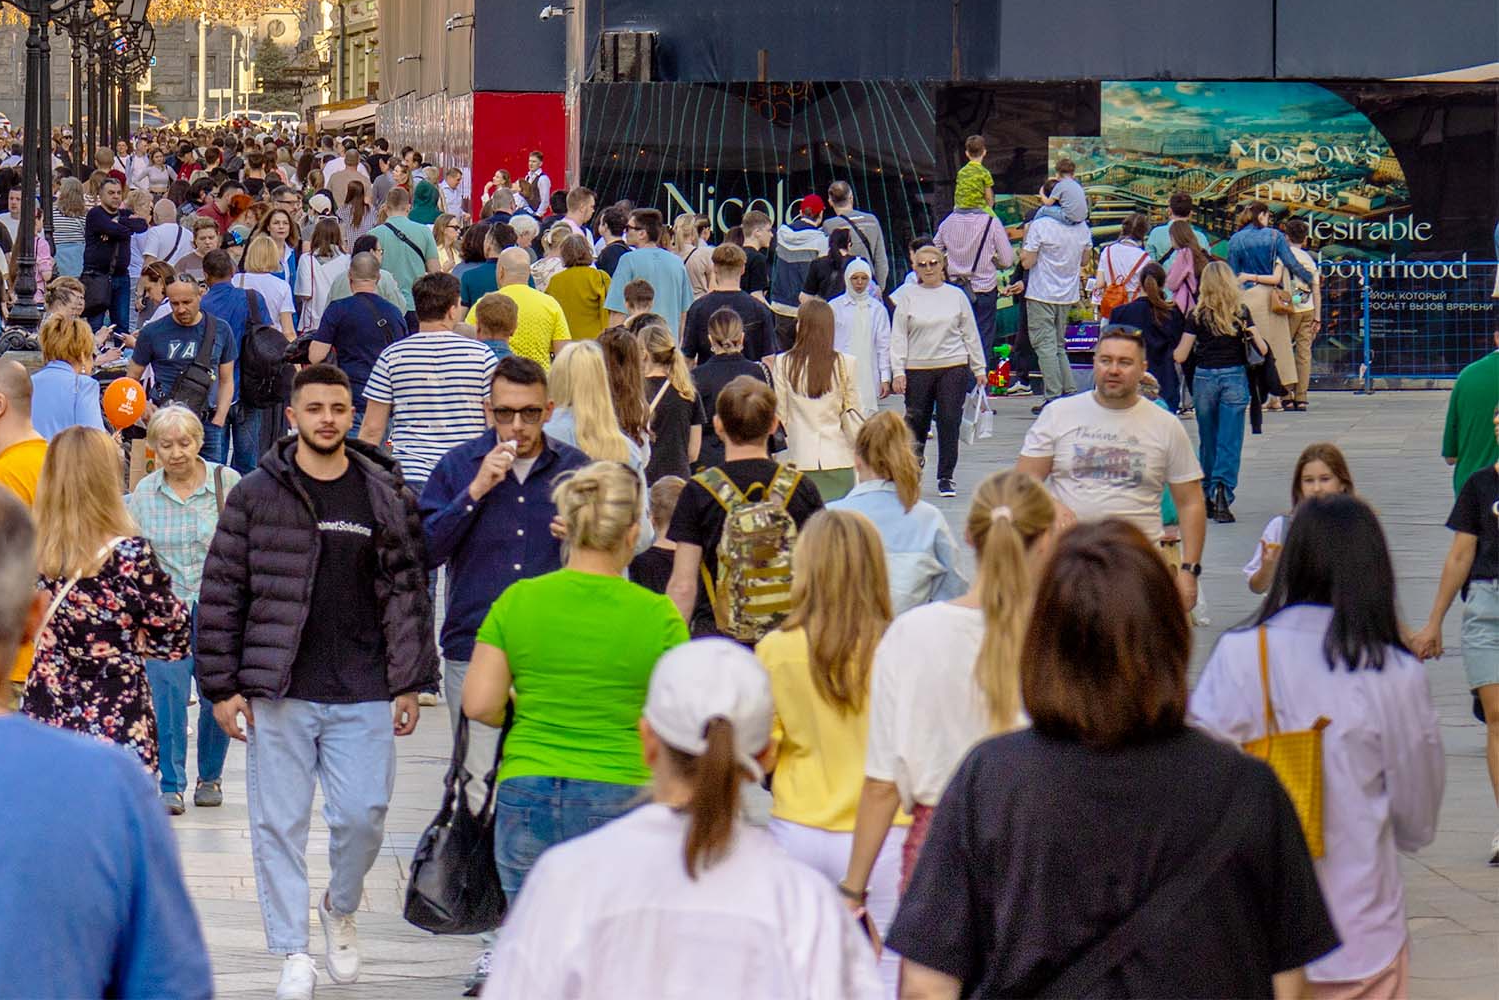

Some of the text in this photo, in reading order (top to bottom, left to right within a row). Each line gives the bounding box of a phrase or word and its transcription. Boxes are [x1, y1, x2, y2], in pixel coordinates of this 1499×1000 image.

[1231, 140, 1382, 164] Moscow's
[1254, 181, 1334, 202] most
[1318, 251, 1468, 280] bourhood
[1399, 290, 1447, 301] КОТОРЫЙ
[1409, 302, 1444, 311] ВЫЗОВ
[1446, 303, 1494, 311] ВРЕМЕНИ
